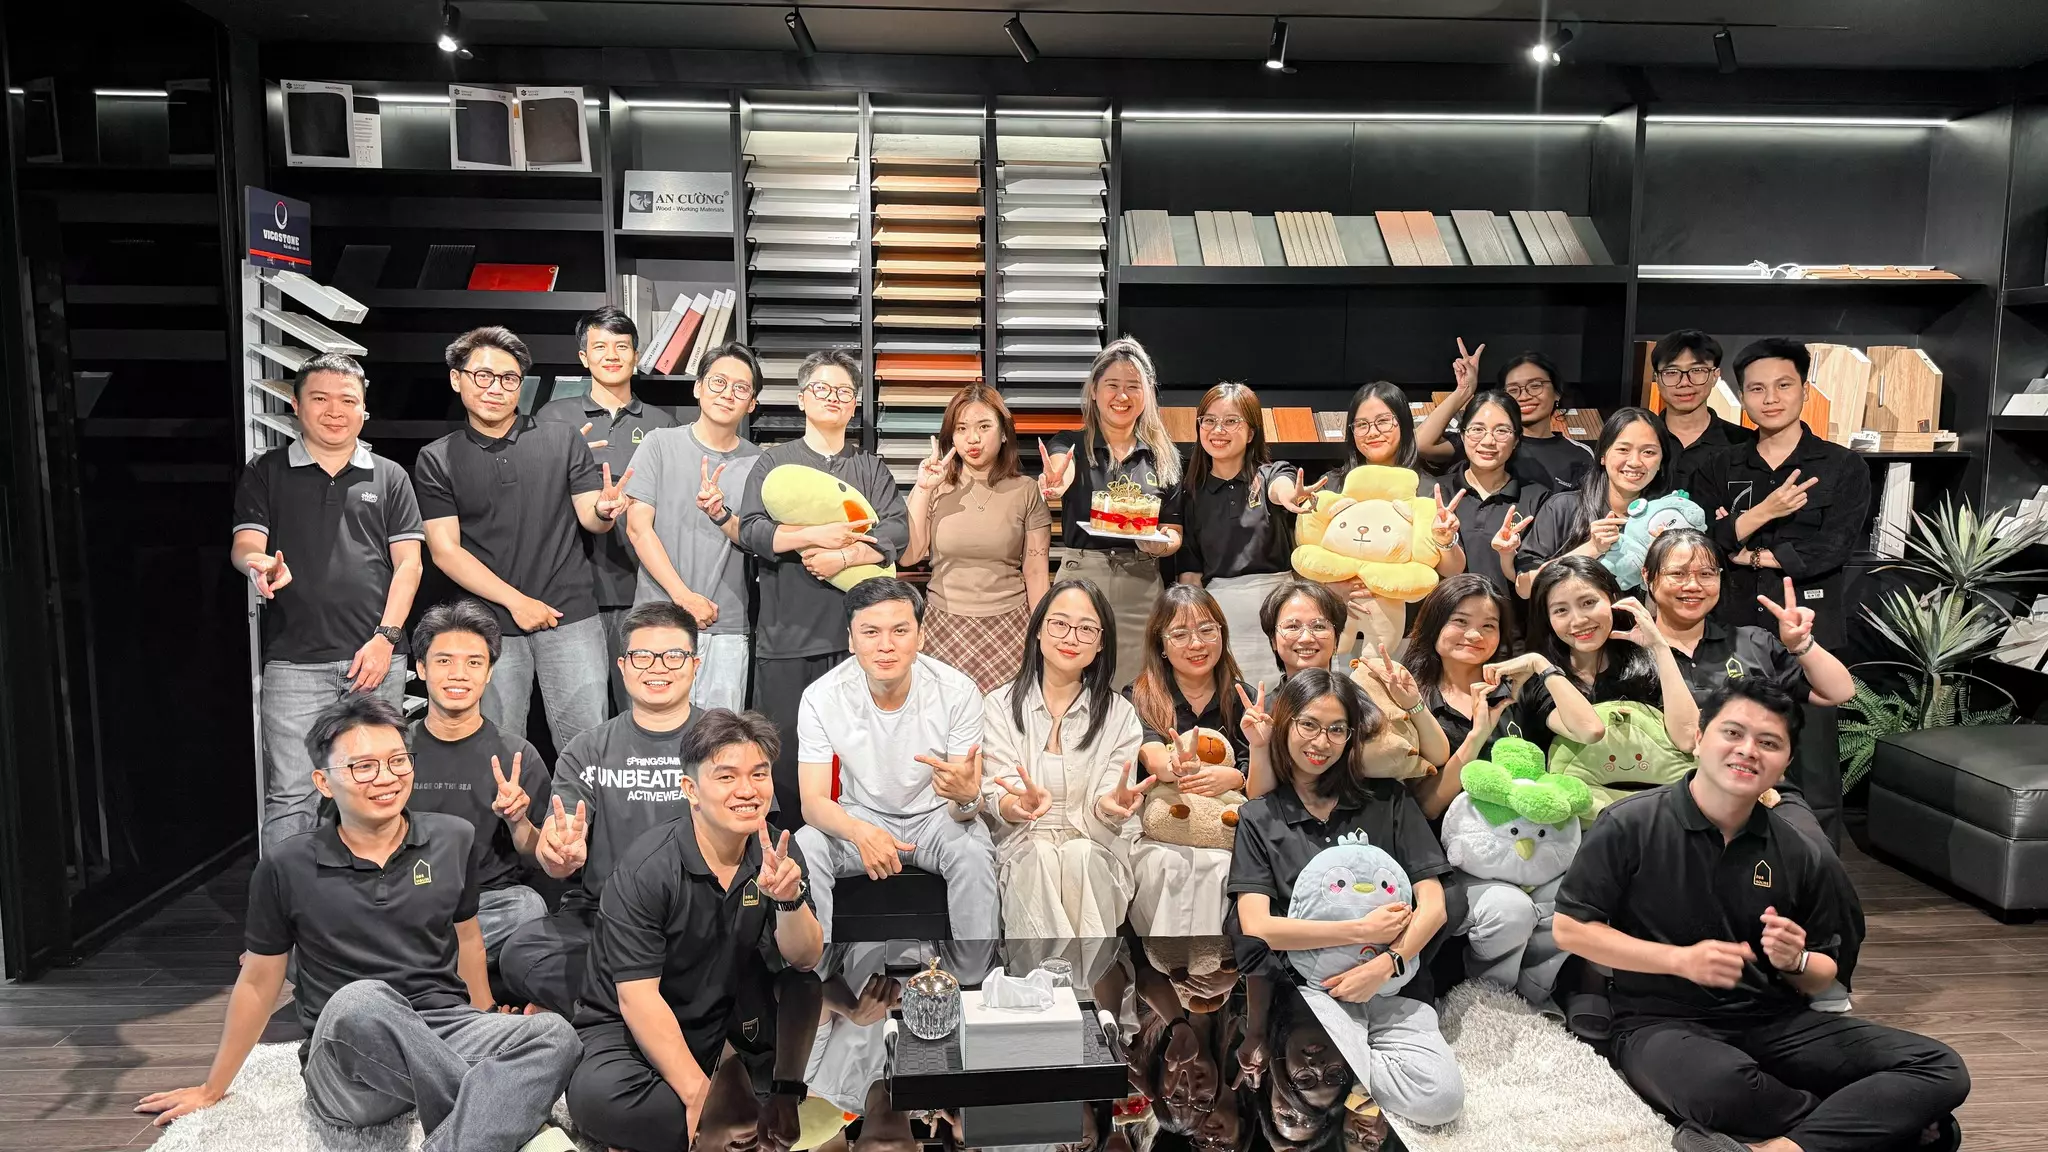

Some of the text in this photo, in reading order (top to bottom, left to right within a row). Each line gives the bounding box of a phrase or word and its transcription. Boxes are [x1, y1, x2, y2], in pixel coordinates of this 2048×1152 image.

[655, 191, 724, 205] AN CƯỜNG
[676, 205, 699, 213] Working
[262, 229, 300, 246] VICOSTONE
[433, 782, 443, 790] OF
[459, 783, 472, 791] SEA
